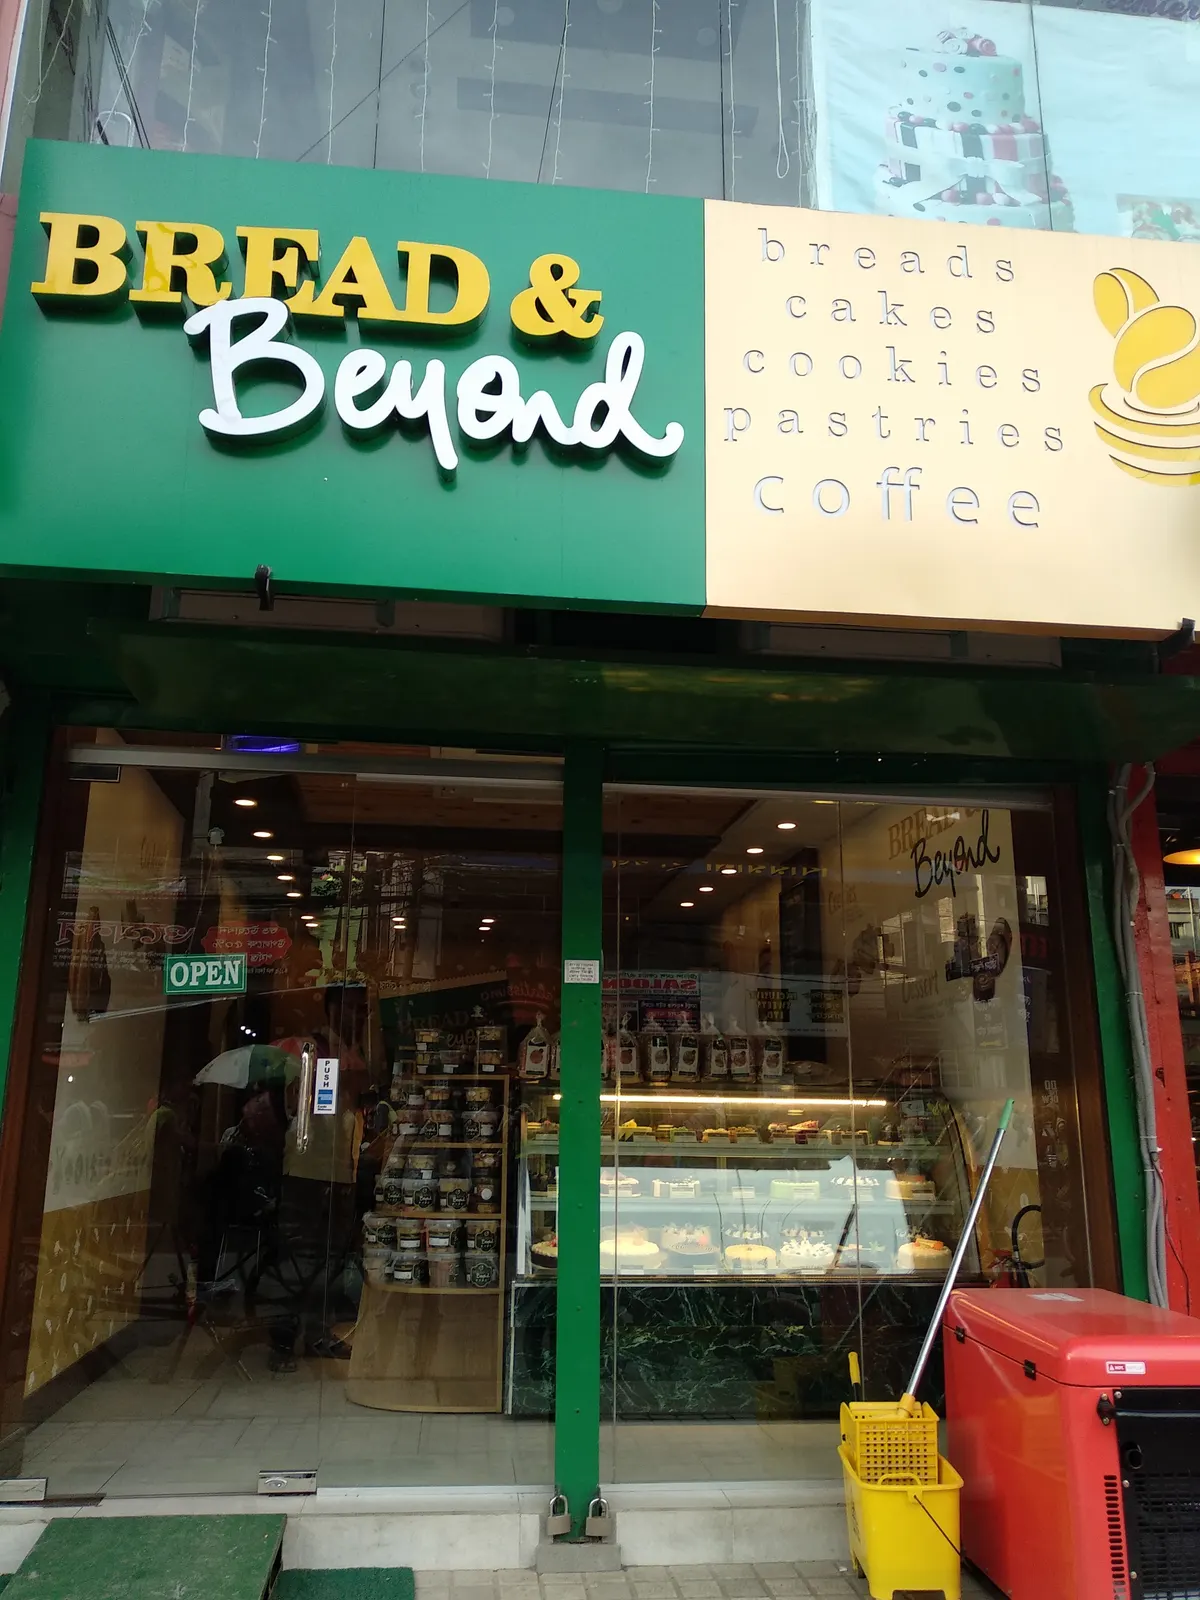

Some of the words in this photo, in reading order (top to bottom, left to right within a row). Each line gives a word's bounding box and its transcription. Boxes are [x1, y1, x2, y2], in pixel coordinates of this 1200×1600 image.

[30, 211, 491, 328] BREAD
[509, 253, 605, 341] &
[757, 227, 1015, 283] breads
[785, 290, 996, 334] cakes
[183, 296, 686, 471] Beyond
[742, 346, 1042, 394] cookies
[723, 405, 1064, 452] pastries
[753, 466, 1041, 529] coffee
[910, 809, 1000, 898] Beyond
[169, 959, 243, 987] OPEN
[322, 1060, 331, 1088] PUSH
